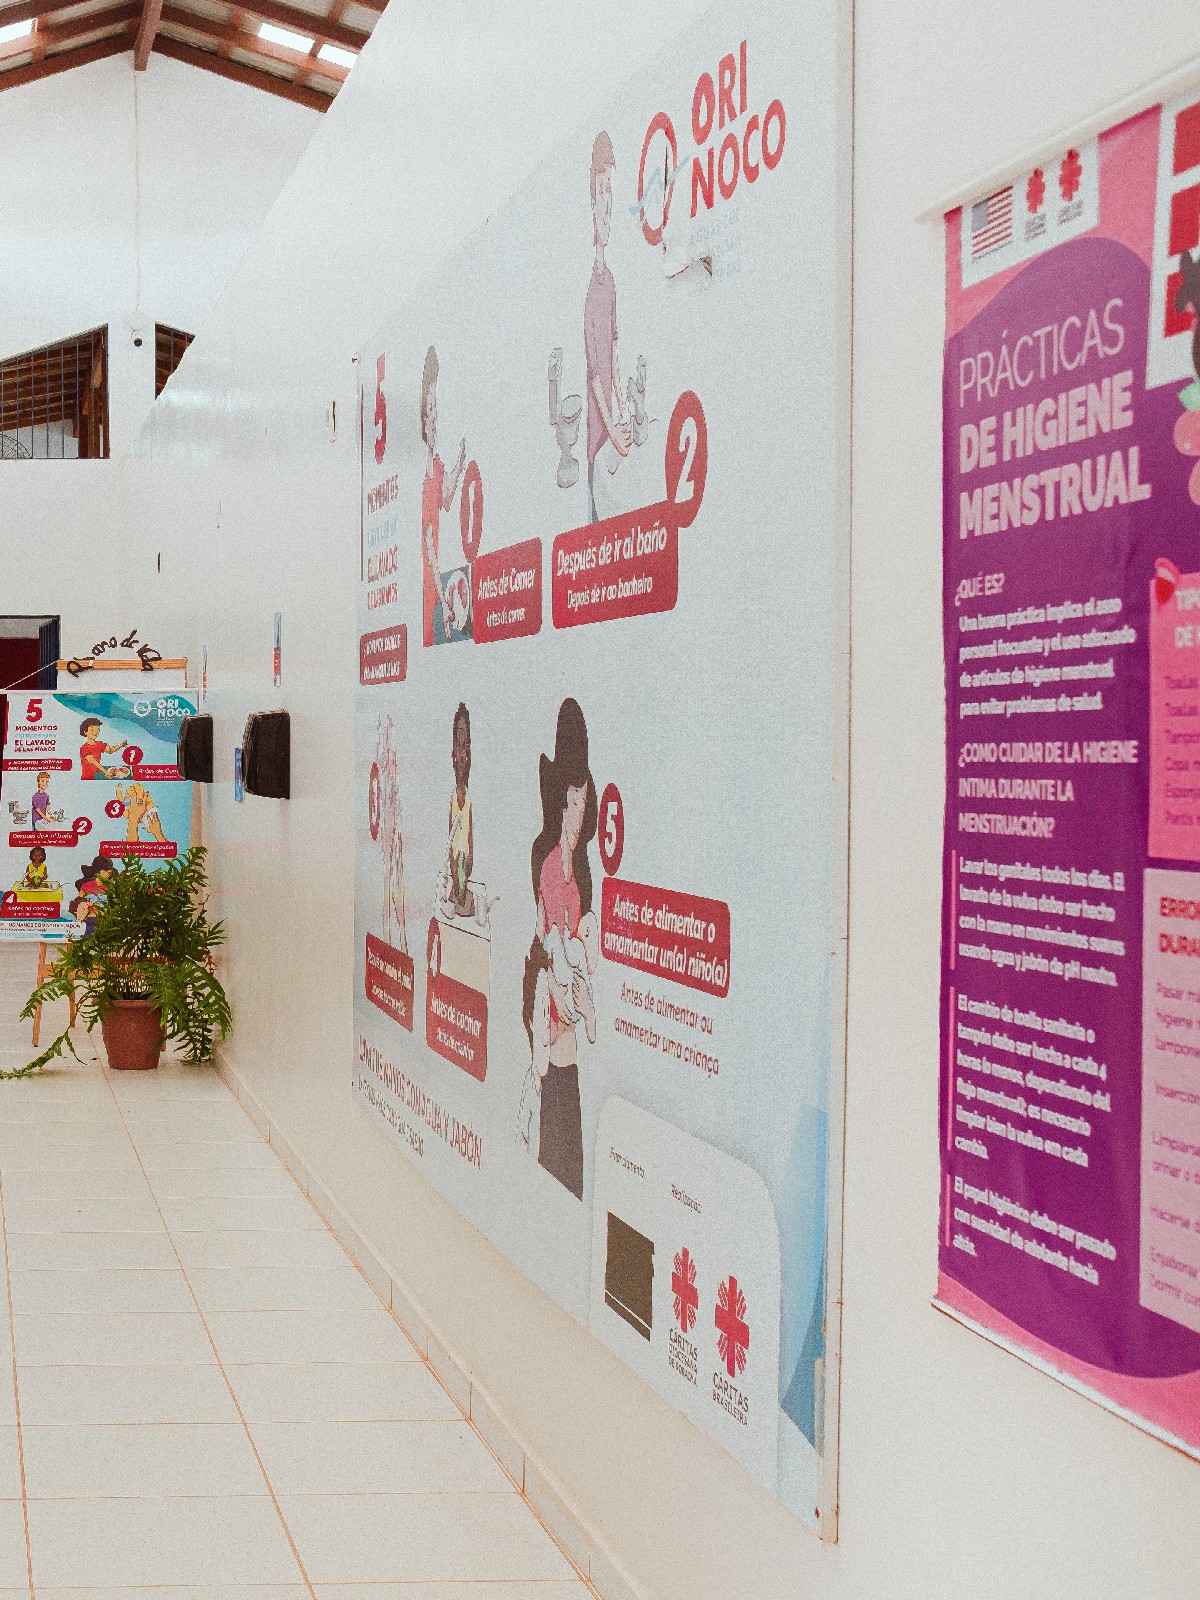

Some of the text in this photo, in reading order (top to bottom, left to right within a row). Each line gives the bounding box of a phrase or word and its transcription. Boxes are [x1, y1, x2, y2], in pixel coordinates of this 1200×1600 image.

[692, 38, 747, 145] ORI
[690, 98, 786, 218] NOCO
[959, 298, 1125, 408] PRÁCTICAS
[374, 352, 387, 464] 5
[960, 370, 1134, 474] DE HIGIENE
[675, 417, 698, 503] 2
[960, 446, 1151, 539] MENSTRUAL
[557, 520, 668, 580] Después de ir al baño
[478, 567, 536, 601] Antes de Comer
[25, 698, 43, 723] 5
[157, 699, 179, 708] ORI
[157, 708, 191, 717] NOCO
[130, 749, 136, 762] 1
[999, 742, 1043, 763] CUIDAR
[1045, 742, 1063, 763] DE
[1064, 742, 1081, 763] LA
[1083, 740, 1139, 763] HIGIENE
[999, 778, 1055, 801] DURANTE
[1057, 779, 1075, 801] LA
[77, 820, 88, 833] 2
[110, 802, 120, 815] 3
[958, 811, 1056, 838] MENSTRUACIÓN?
[604, 801, 618, 858] 5
[6, 893, 15, 904] 4
[613, 893, 716, 944] Antes de alimentar o
[620, 981, 643, 1008] Antes
[644, 989, 655, 1013] de
[656, 993, 699, 1027] alimentar
[669, 1327, 698, 1361] CÁRITAS
[712, 1372, 749, 1413] CÁRITAS
[712, 1389, 748, 1426] BRASILEIRA
